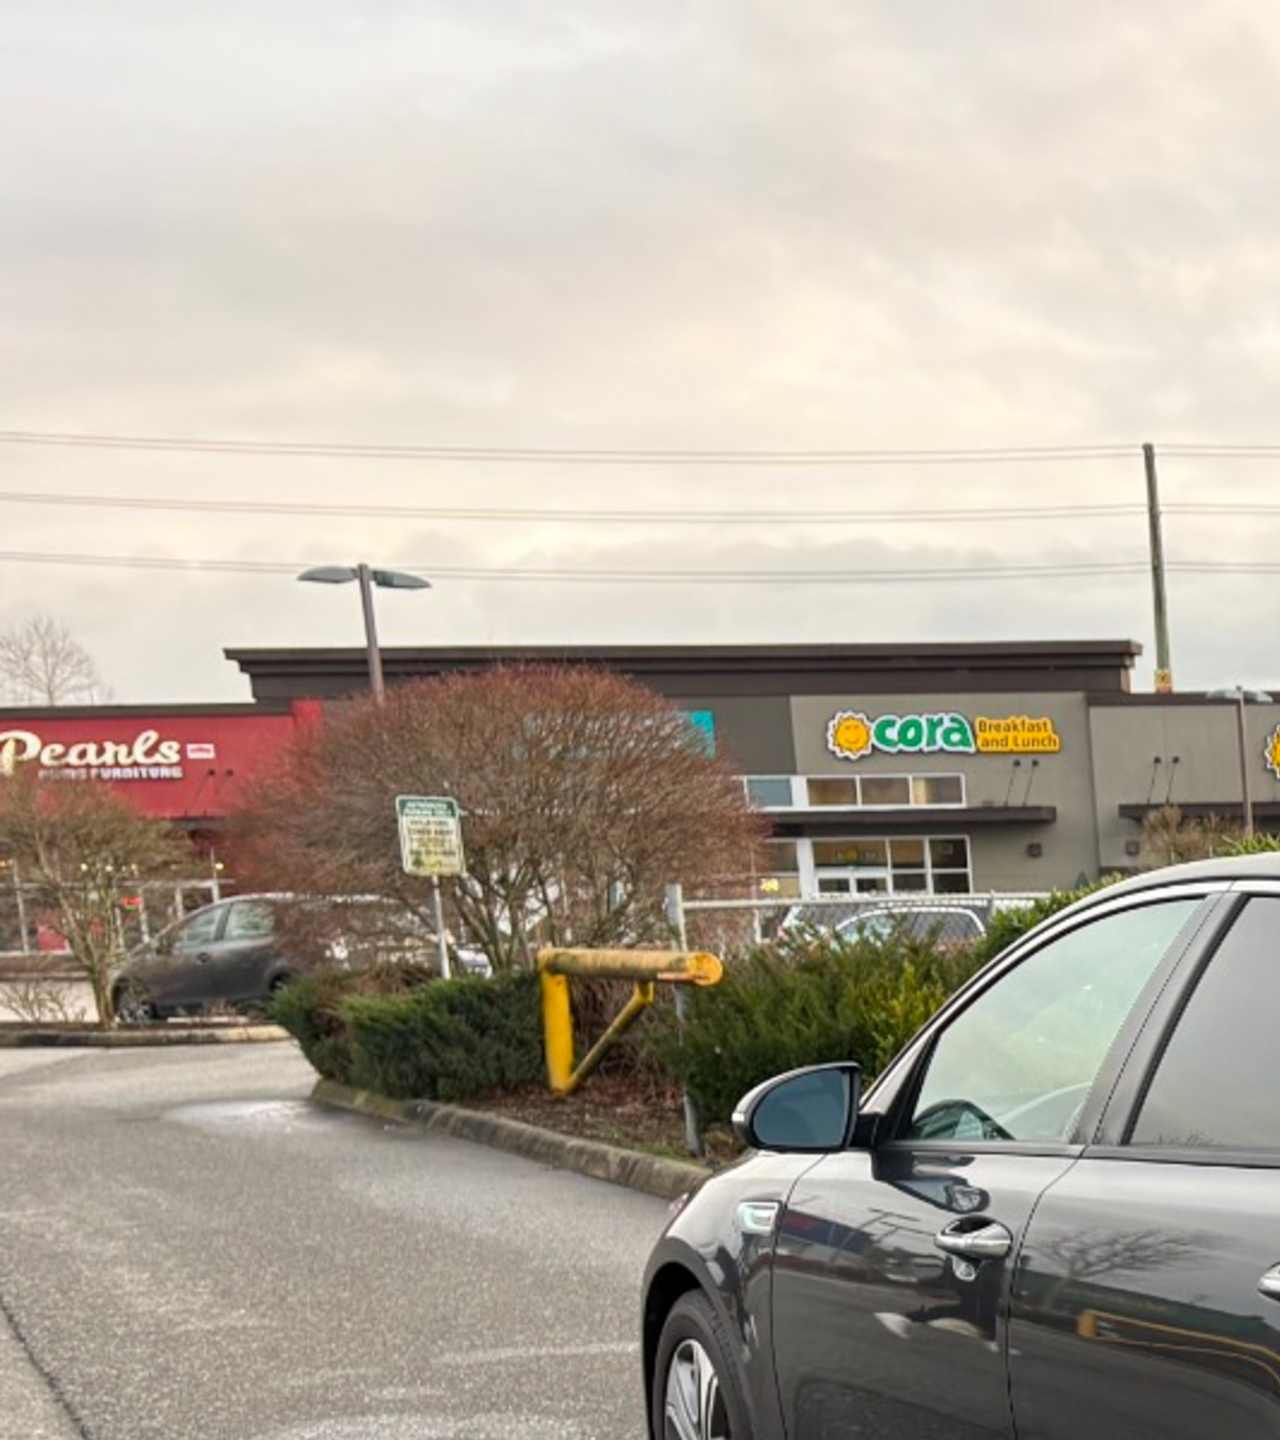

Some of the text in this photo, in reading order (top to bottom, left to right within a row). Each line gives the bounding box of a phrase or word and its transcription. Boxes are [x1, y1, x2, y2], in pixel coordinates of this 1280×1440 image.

[873, 716, 972, 748] cora
[978, 717, 1049, 733] Breakfast
[0, 730, 181, 777] Pearls
[980, 734, 1058, 749] and Lunch
